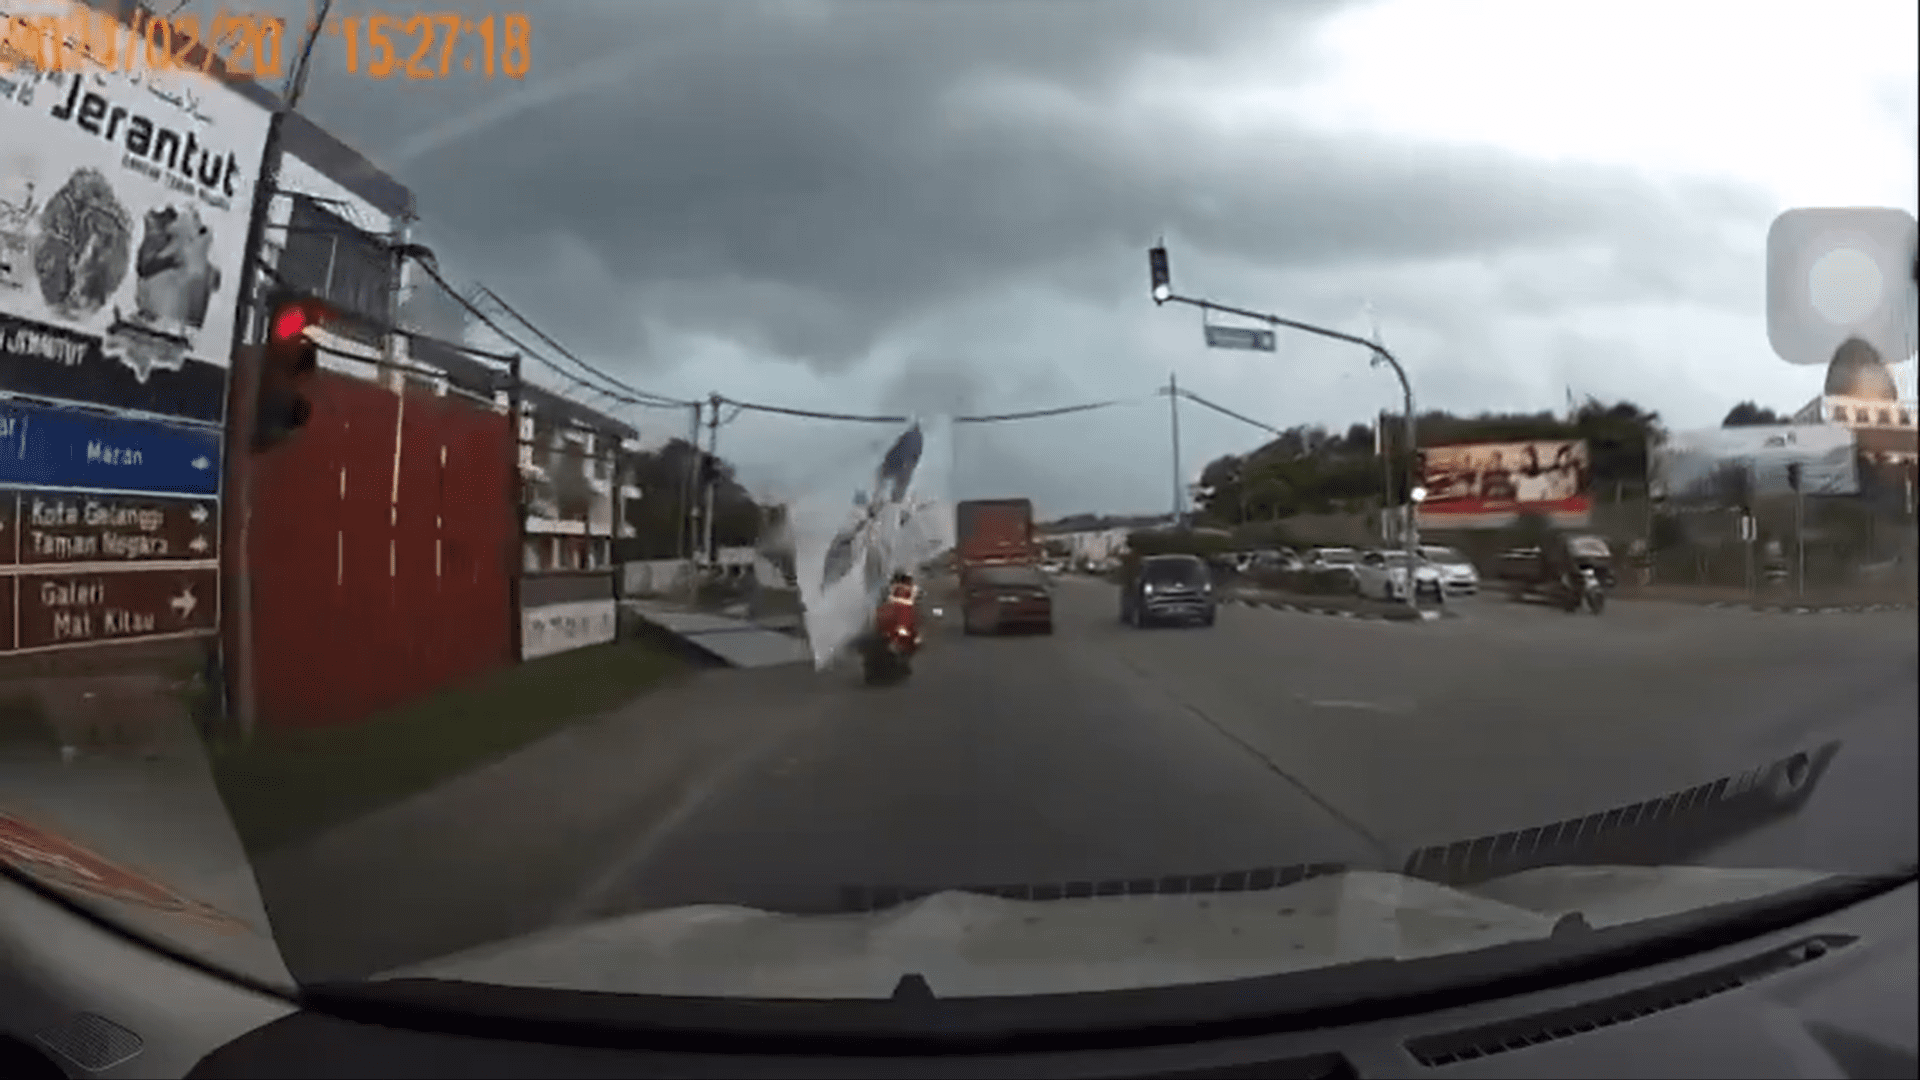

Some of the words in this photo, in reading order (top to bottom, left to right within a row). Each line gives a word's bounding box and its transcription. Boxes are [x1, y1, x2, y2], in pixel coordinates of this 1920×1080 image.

[51, 73, 239, 198] Jerantut
[86, 439, 143, 465] Maran
[32, 499, 78, 525] Kota
[31, 531, 97, 557] Taman
[102, 531, 168, 558] Negara
[41, 581, 104, 606] Galeri
[54, 610, 90, 639] Mat
